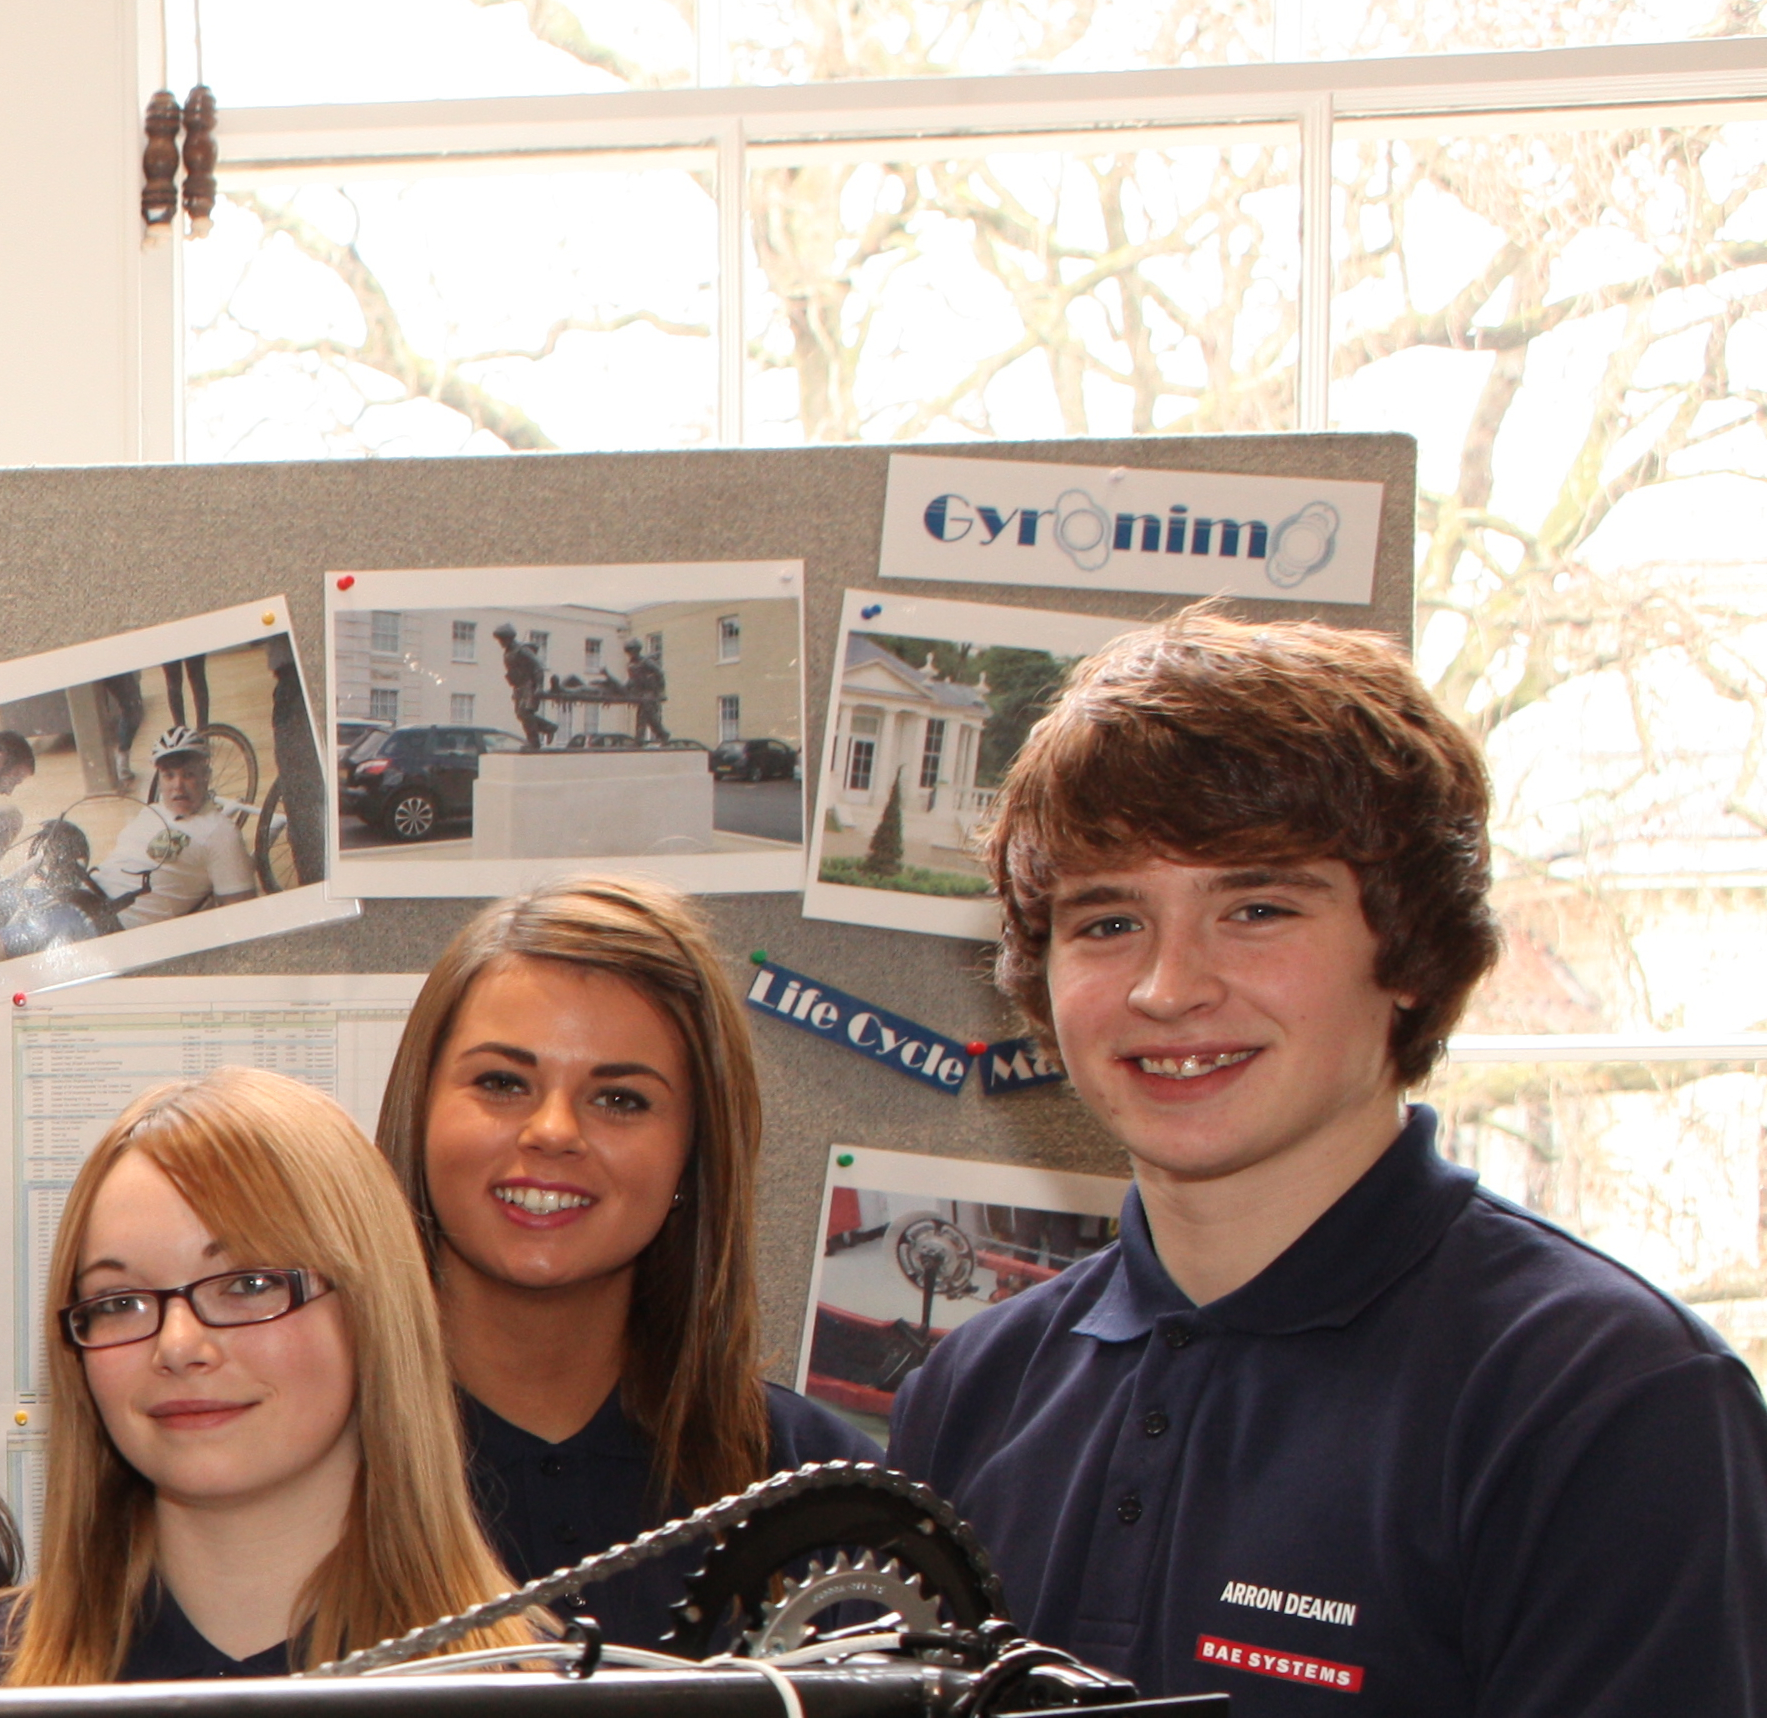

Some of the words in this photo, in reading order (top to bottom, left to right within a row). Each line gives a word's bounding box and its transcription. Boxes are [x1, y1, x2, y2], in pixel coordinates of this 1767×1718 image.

[747, 969, 840, 1031] Life
[846, 1012, 966, 1085] Cycle
[991, 1053, 1060, 1087] Ma
[1220, 1580, 1284, 1613] ARRON
[1283, 1593, 1357, 1627] DEAKIN
[1201, 1641, 1243, 1665] BAE
[1247, 1651, 1352, 1687] SYSTEMS
